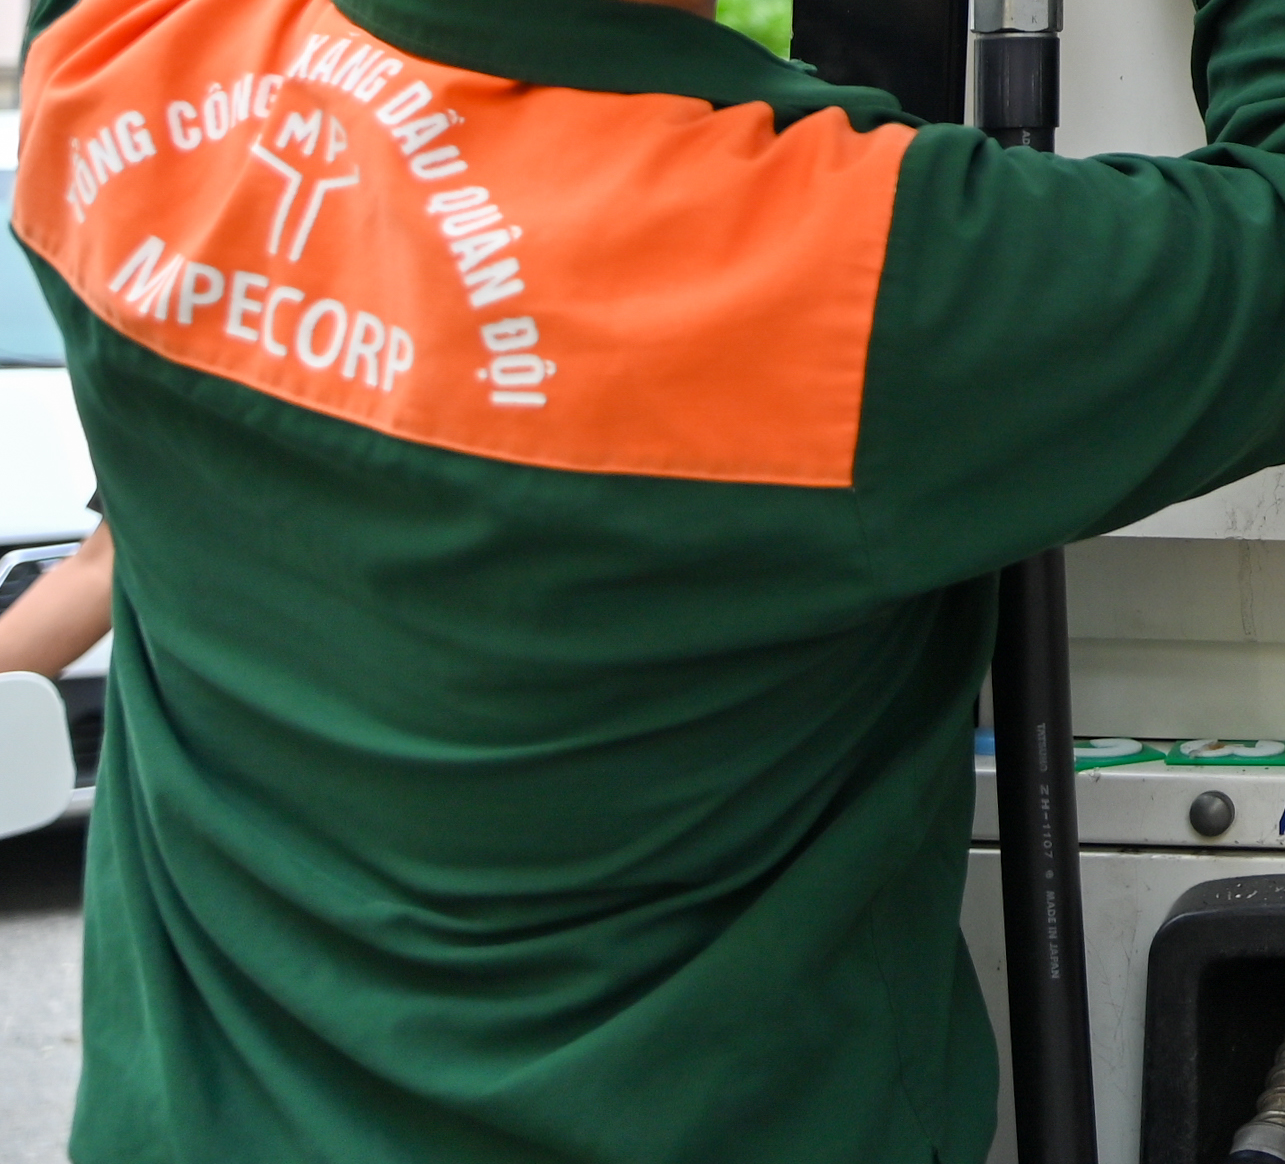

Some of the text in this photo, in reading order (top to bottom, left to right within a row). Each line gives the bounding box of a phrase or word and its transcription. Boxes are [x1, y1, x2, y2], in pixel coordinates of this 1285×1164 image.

[167, 73, 284, 150] CÔNG
[426, 186, 524, 308] QUÂN
[476, 316, 557, 408] ĐỘI
[1046, 890, 1057, 923] MADE
[1048, 926, 1057, 939] IN
[1048, 942, 1060, 979] JAPAN
